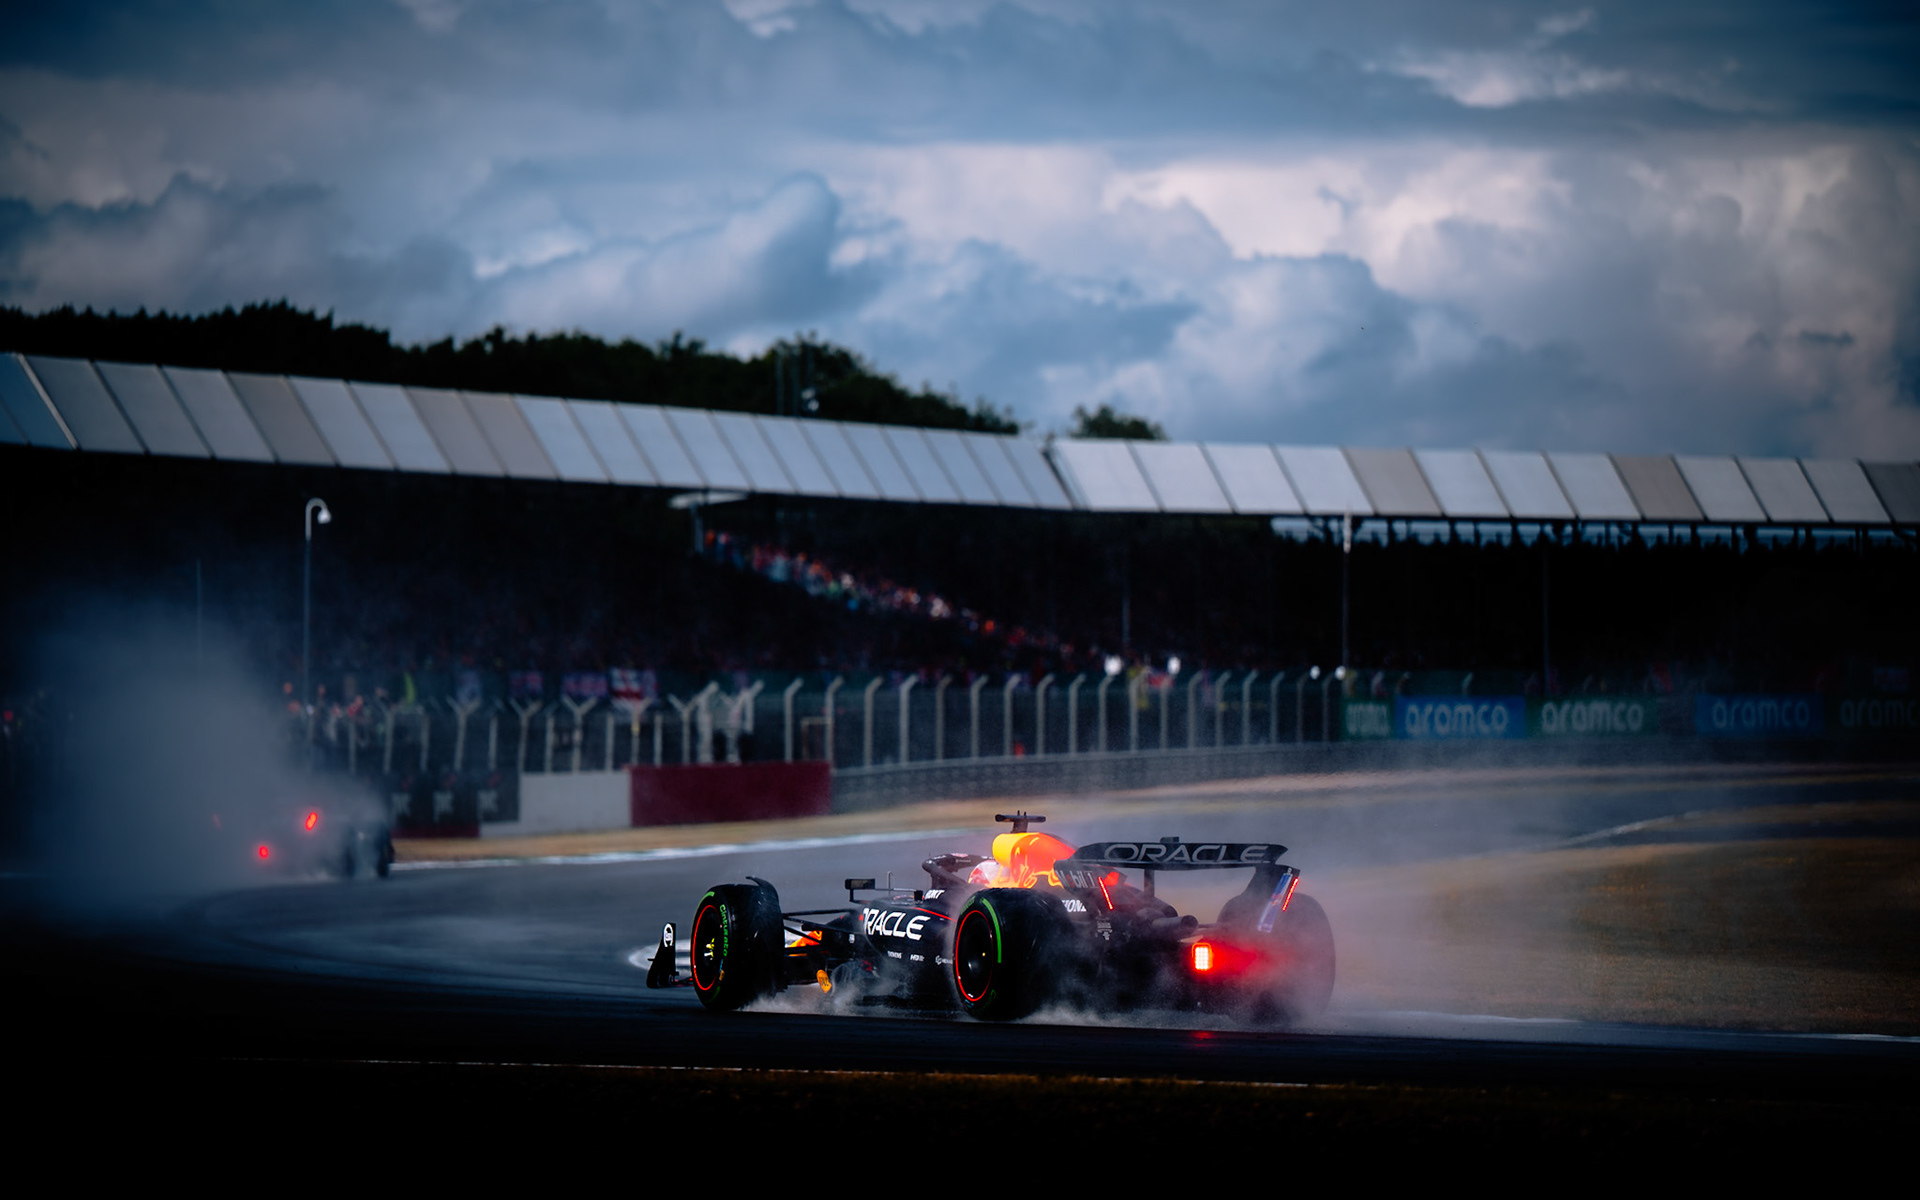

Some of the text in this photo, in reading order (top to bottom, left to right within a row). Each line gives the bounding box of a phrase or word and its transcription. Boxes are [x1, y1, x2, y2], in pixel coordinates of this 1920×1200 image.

[1405, 703, 1510, 737] aramco
[1541, 700, 1645, 733] aramco
[1711, 700, 1810, 729] aramco
[1839, 699, 1920, 728] aramc
[1104, 843, 1271, 863] ORACLE
